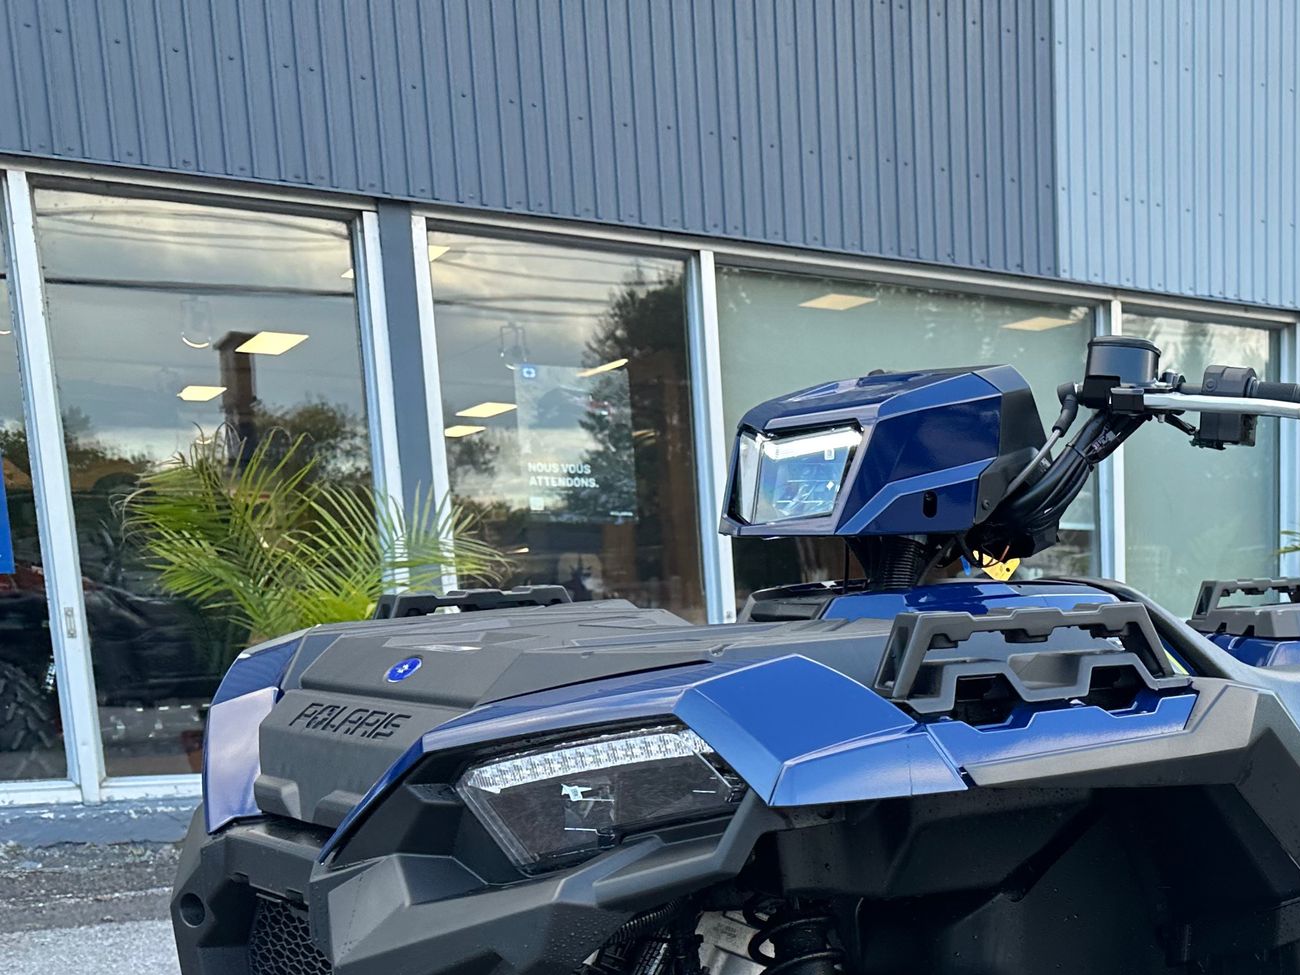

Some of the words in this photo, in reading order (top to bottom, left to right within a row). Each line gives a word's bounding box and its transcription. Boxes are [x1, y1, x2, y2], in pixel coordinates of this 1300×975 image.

[527, 462, 559, 473] NOUS
[561, 463, 591, 475] VOUS
[528, 475, 600, 488] ATTENDONS.
[288, 702, 412, 739] POLARIS
